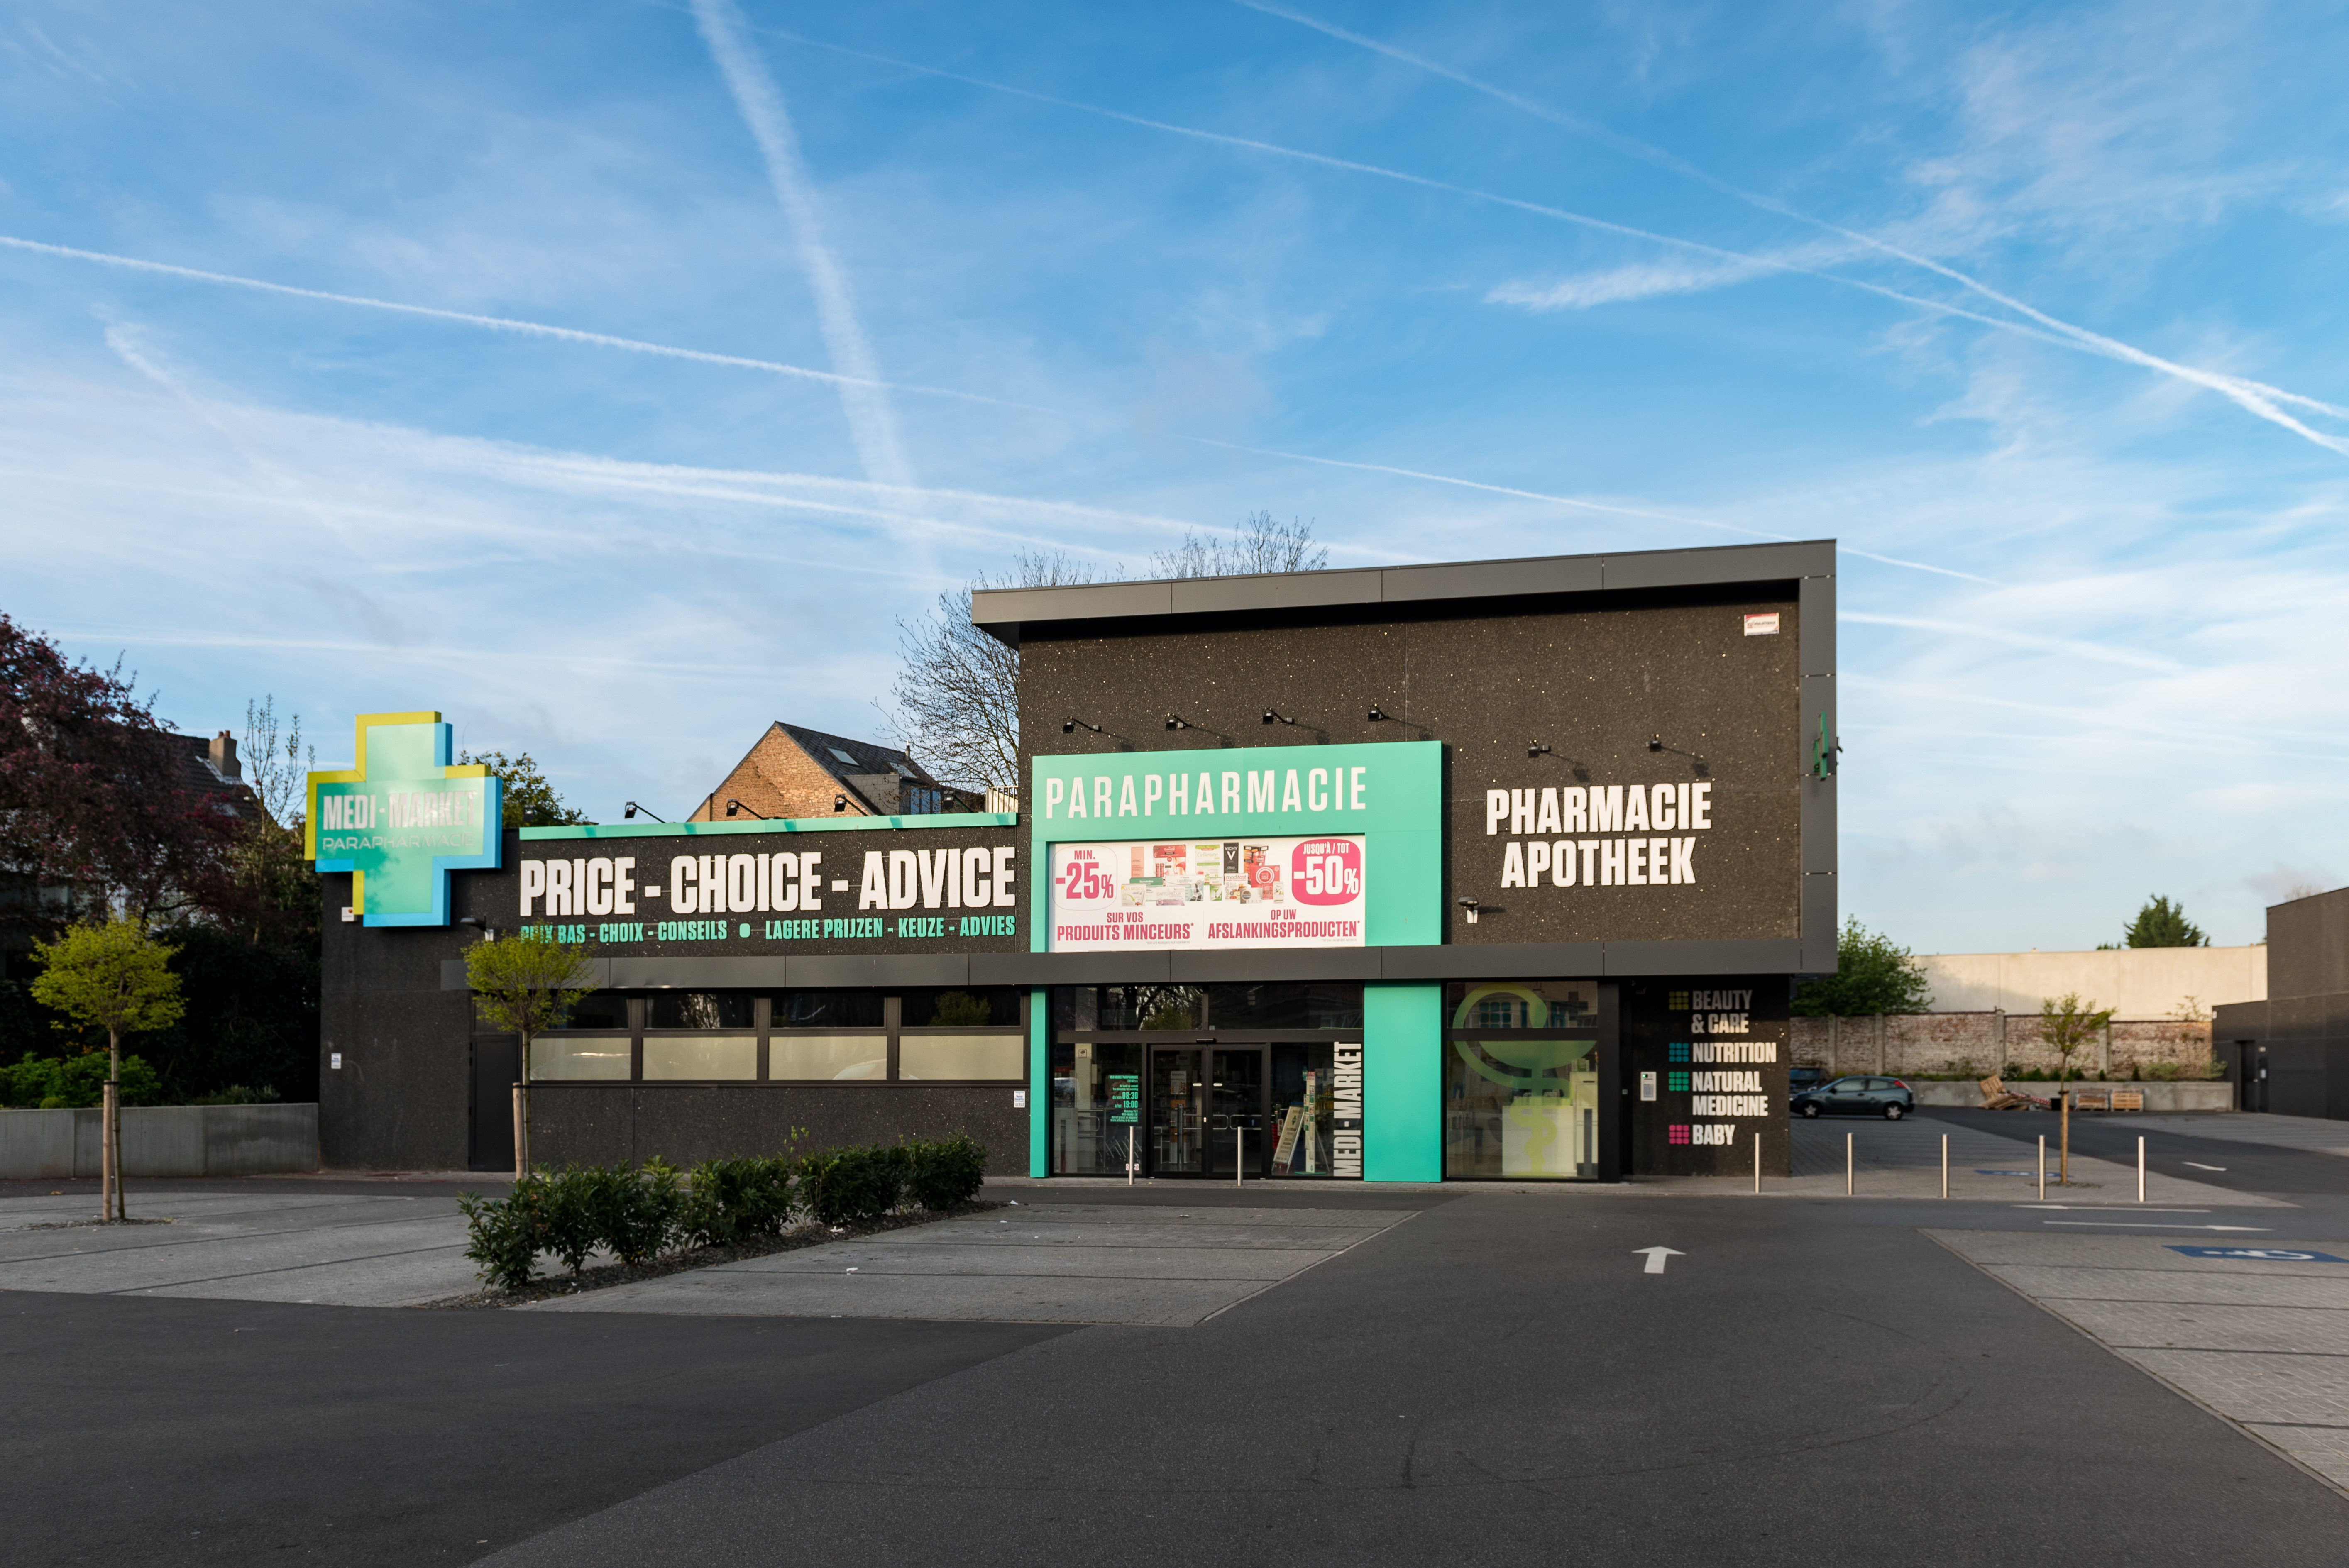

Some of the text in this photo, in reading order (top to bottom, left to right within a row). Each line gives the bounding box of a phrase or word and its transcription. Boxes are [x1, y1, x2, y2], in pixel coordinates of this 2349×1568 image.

[1046, 767, 1366, 819] PARAPHARMACIE
[1486, 782, 1711, 835] PHARMACIE
[322, 833, 474, 850] PARAPHARMACIE
[1303, 841, 1331, 855] JUSQU'À
[1337, 843, 1349, 854] TOT
[1074, 850, 1095, 860] MIN.
[1501, 837, 1696, 888] APOTHEEK
[520, 857, 635, 916] PRICE
[671, 852, 821, 914] CHOICE
[858, 847, 1015, 910] ADVICE
[1056, 862, 1114, 899] -25%
[1293, 855, 1359, 895] -50%
[1107, 912, 1144, 923] SUR VOS
[1271, 909, 1297, 920] OP UW
[557, 924, 586, 944] BAS
[599, 923, 644, 943] CHOIX
[658, 920, 727, 941] CONSEILS
[765, 919, 820, 940] LAGERE
[824, 918, 883, 939] PRIJZEN
[898, 917, 944, 938] KEUZE
[959, 916, 1015, 936] ADVIES
[1057, 925, 1120, 941] PRODUITS
[1692, 990, 1753, 1010] BEAUTY
[1691, 1013, 1749, 1033] & CARE
[1692, 1042, 1777, 1063] NUTRITION
[1692, 1071, 1762, 1092] NATURAL
[1692, 1095, 1768, 1116] MEDICINE
[1692, 1124, 1735, 1145] BABY
